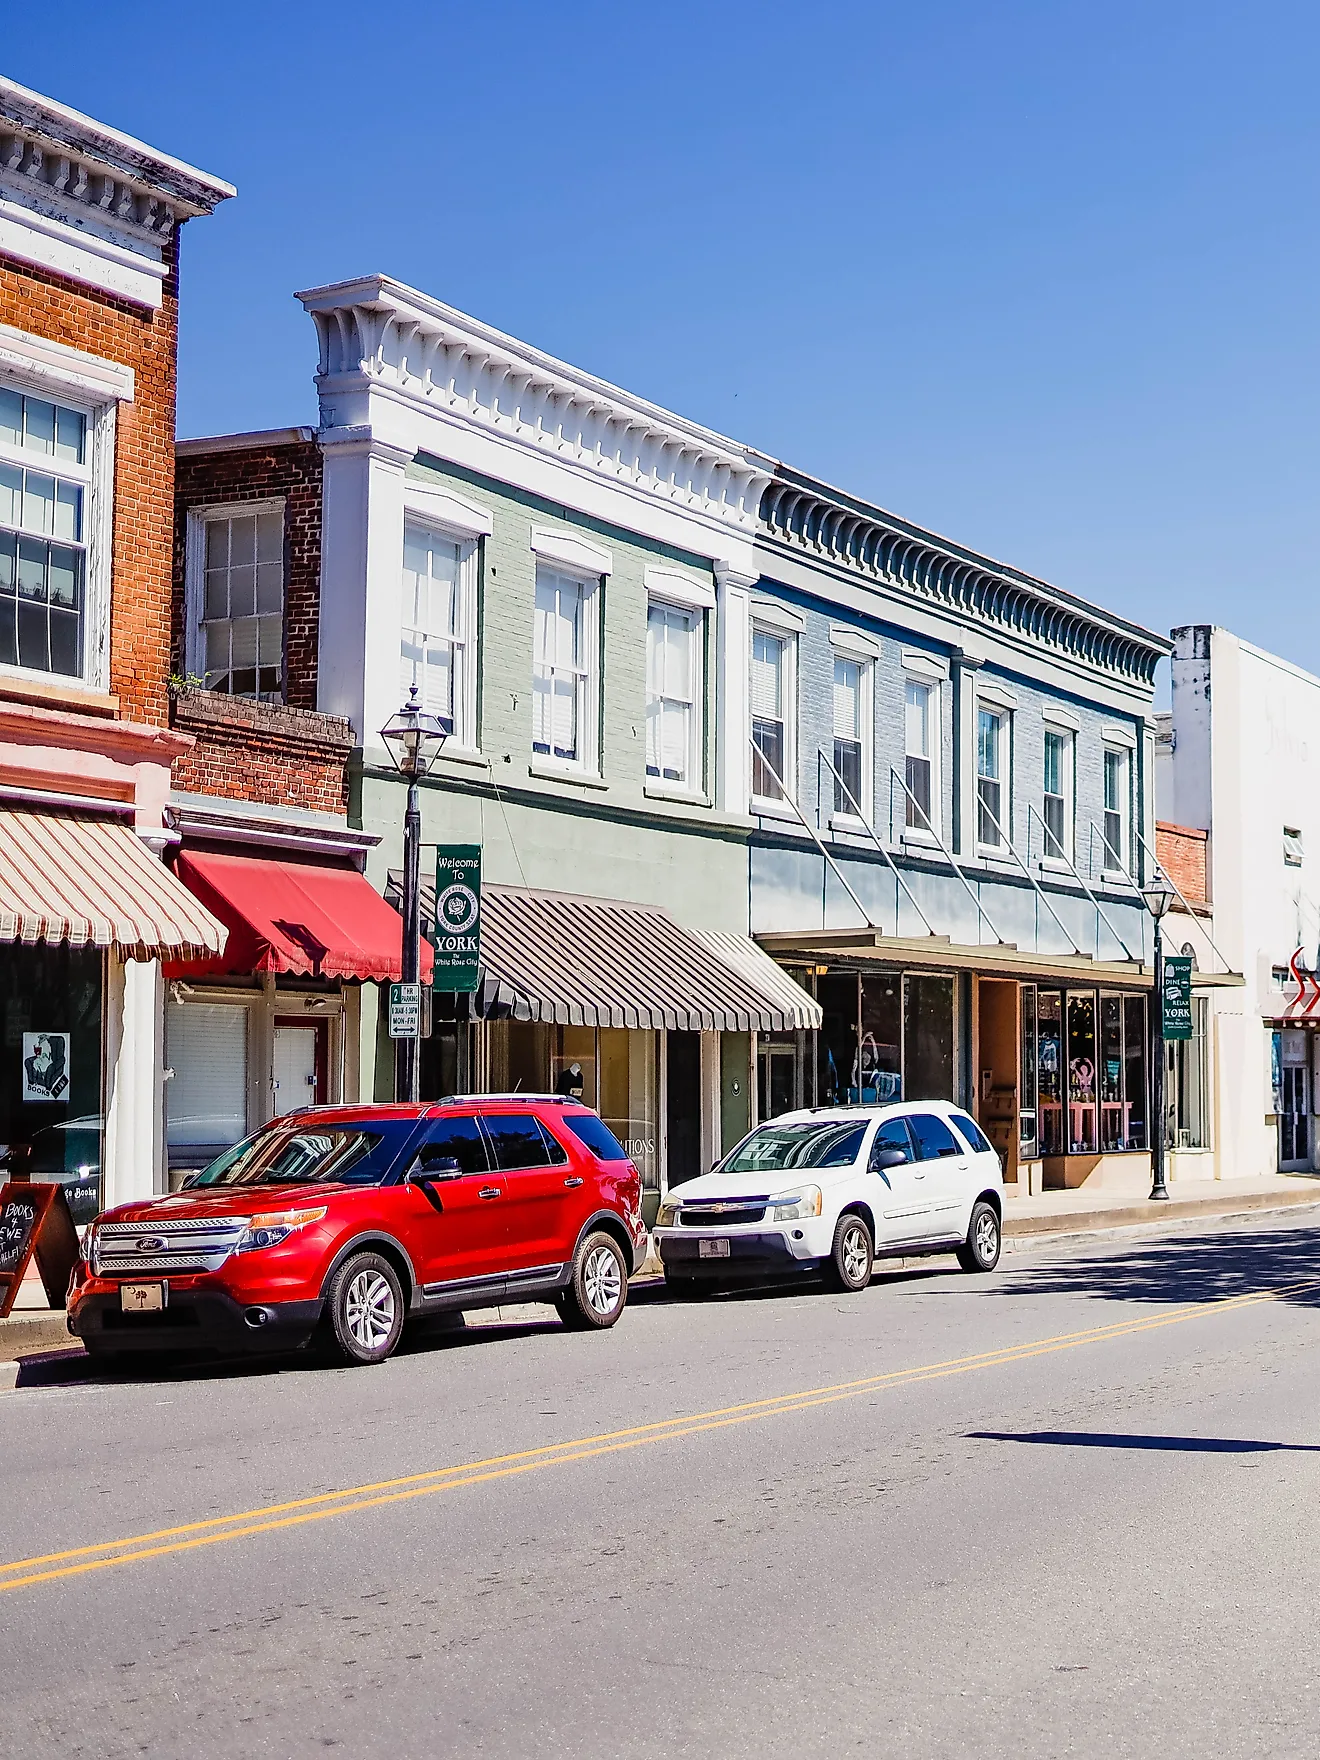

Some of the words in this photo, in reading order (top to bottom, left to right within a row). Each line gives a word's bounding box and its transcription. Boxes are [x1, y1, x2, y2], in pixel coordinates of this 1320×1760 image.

[438, 857, 480, 868] Welcome
[452, 869, 464, 880] To
[435, 936, 478, 951] YORK
[434, 958, 450, 966] White
[466, 958, 478, 966] City
[394, 988, 398, 1002] 2
[1164, 1008, 1190, 1018] YORK
[28, 1084, 50, 1097] BOOKS
[4, 1202, 34, 1220] BOOKS
[0, 1226, 22, 1240] EWE
[140, 1238, 158, 1248] Ford
